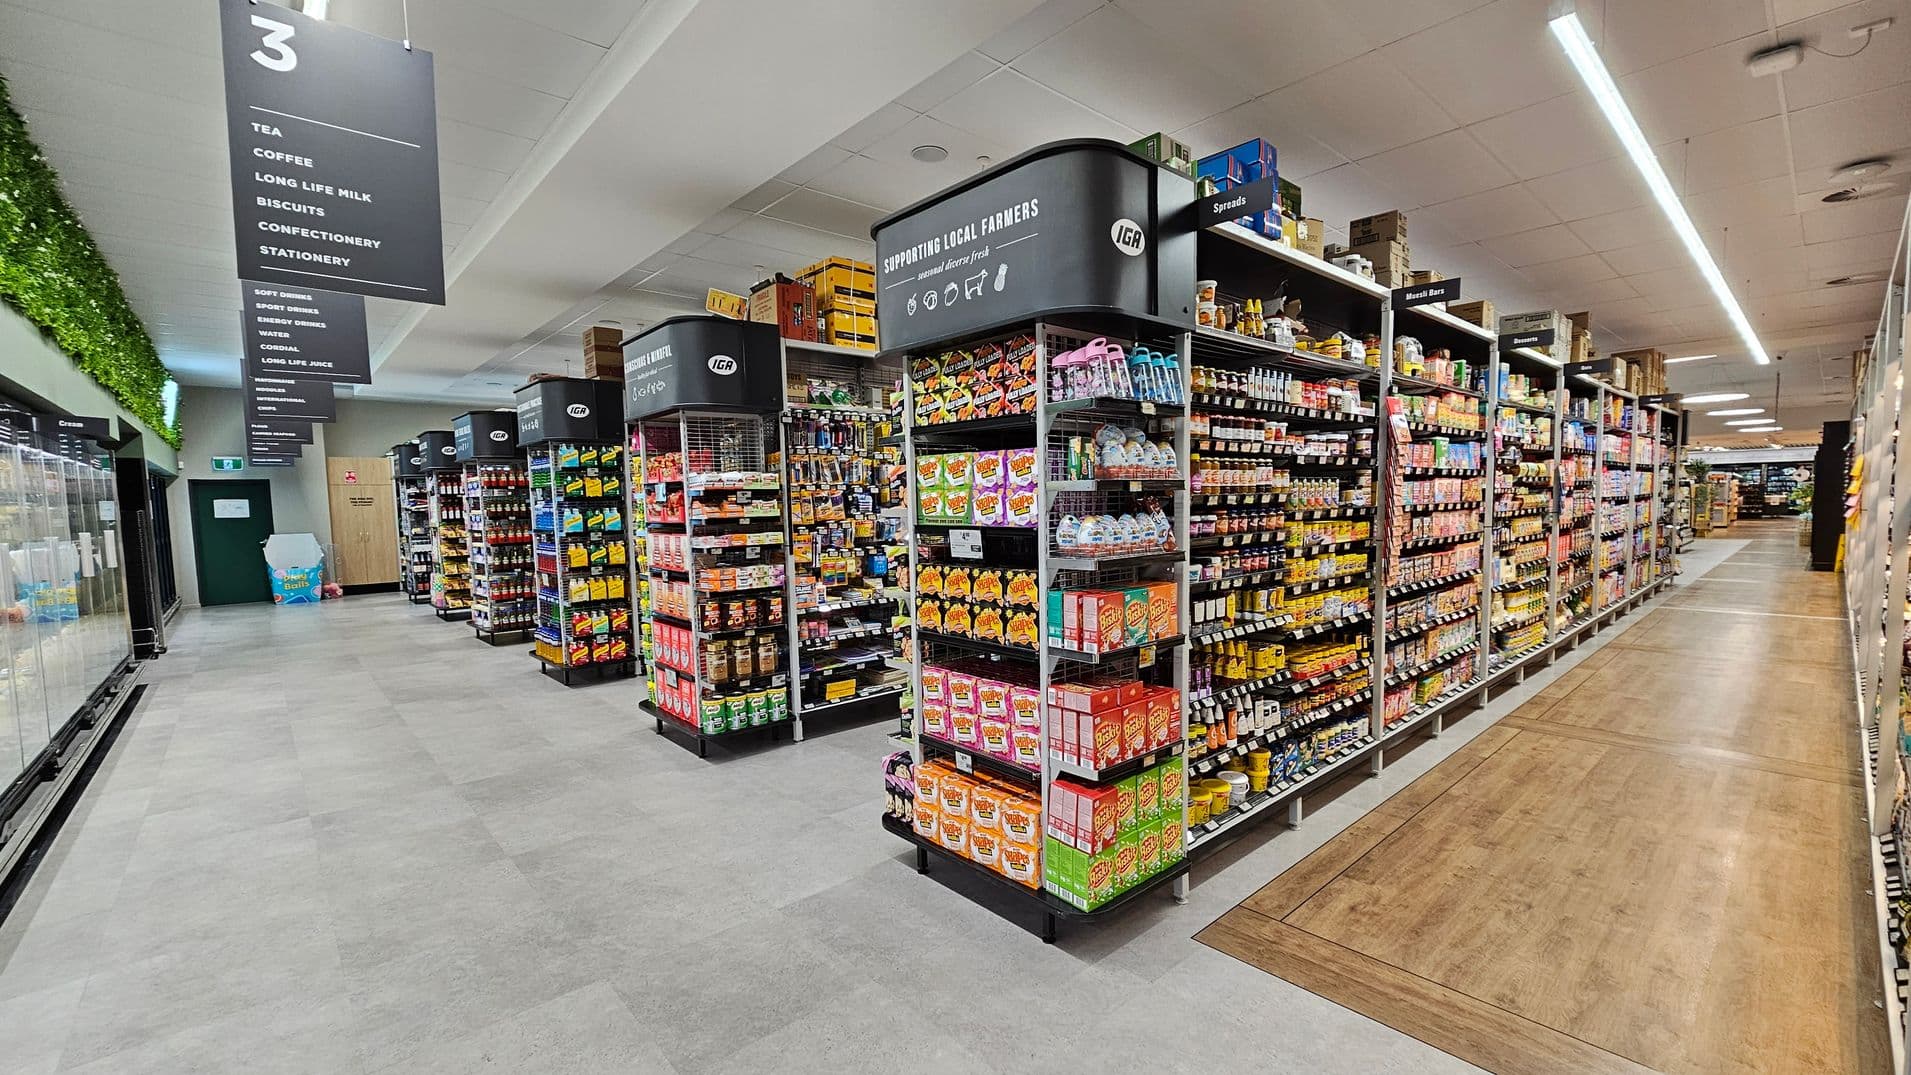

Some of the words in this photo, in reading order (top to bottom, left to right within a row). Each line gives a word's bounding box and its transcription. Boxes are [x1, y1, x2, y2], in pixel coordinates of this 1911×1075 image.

[250, 14, 297, 72] 3
[251, 122, 282, 138] TEA
[253, 147, 314, 168] COFFEE
[255, 172, 297, 188] LONG
[302, 181, 333, 196] LIFE
[338, 187, 372, 203] MILK
[257, 196, 325, 217] BISCUITS
[1213, 196, 1247, 215] Spreads
[258, 221, 381, 249] CONFECTIONERY
[884, 237, 941, 274] SUPPORTING
[944, 222, 978, 251] LOCAL
[981, 198, 1040, 236] FARMERS
[1115, 224, 1142, 249] IGA
[259, 245, 350, 267] STATIONERY
[917, 261, 944, 281] seasonal
[945, 256, 969, 271] diverse
[970, 245, 990, 265] fresh
[254, 289, 278, 297] SOFT
[280, 292, 312, 300] DRINKS
[1406, 290, 1428, 300] Muesli
[1428, 288, 1444, 297] Bars
[256, 303, 284, 312] SPORT
[287, 306, 319, 314] DRINKS
[257, 316, 292, 326] ENERGY
[294, 320, 326, 328] DRINKS
[258, 330, 290, 338] WATER
[1513, 336, 1538, 344] Desserts
[260, 344, 300, 352] CORDIAL
[712, 359, 734, 370] IGA
[570, 406, 587, 415] IGA
[58, 420, 84, 428] Cream
